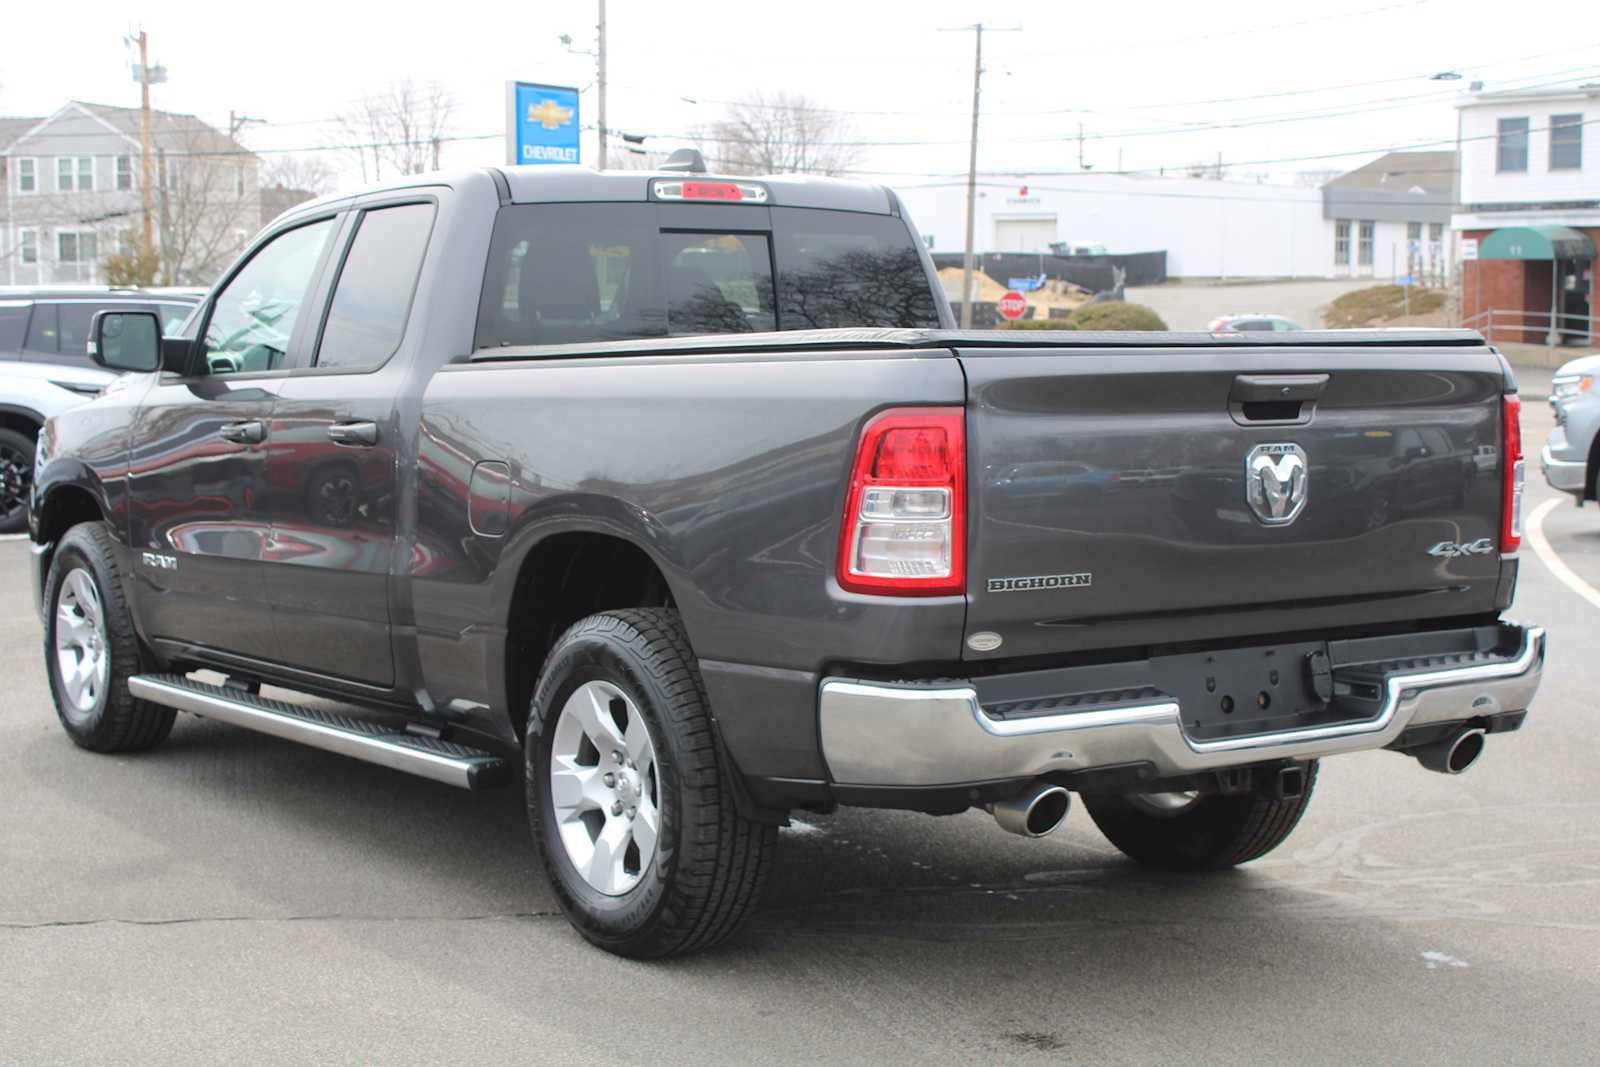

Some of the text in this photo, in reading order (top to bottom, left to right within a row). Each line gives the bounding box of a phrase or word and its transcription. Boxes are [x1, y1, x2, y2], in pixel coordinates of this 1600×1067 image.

[523, 144, 577, 160] CHEVROLET
[1001, 299, 1024, 310] STOP
[142, 552, 177, 569] RAM
[987, 573, 1092, 592] BIGHORN
